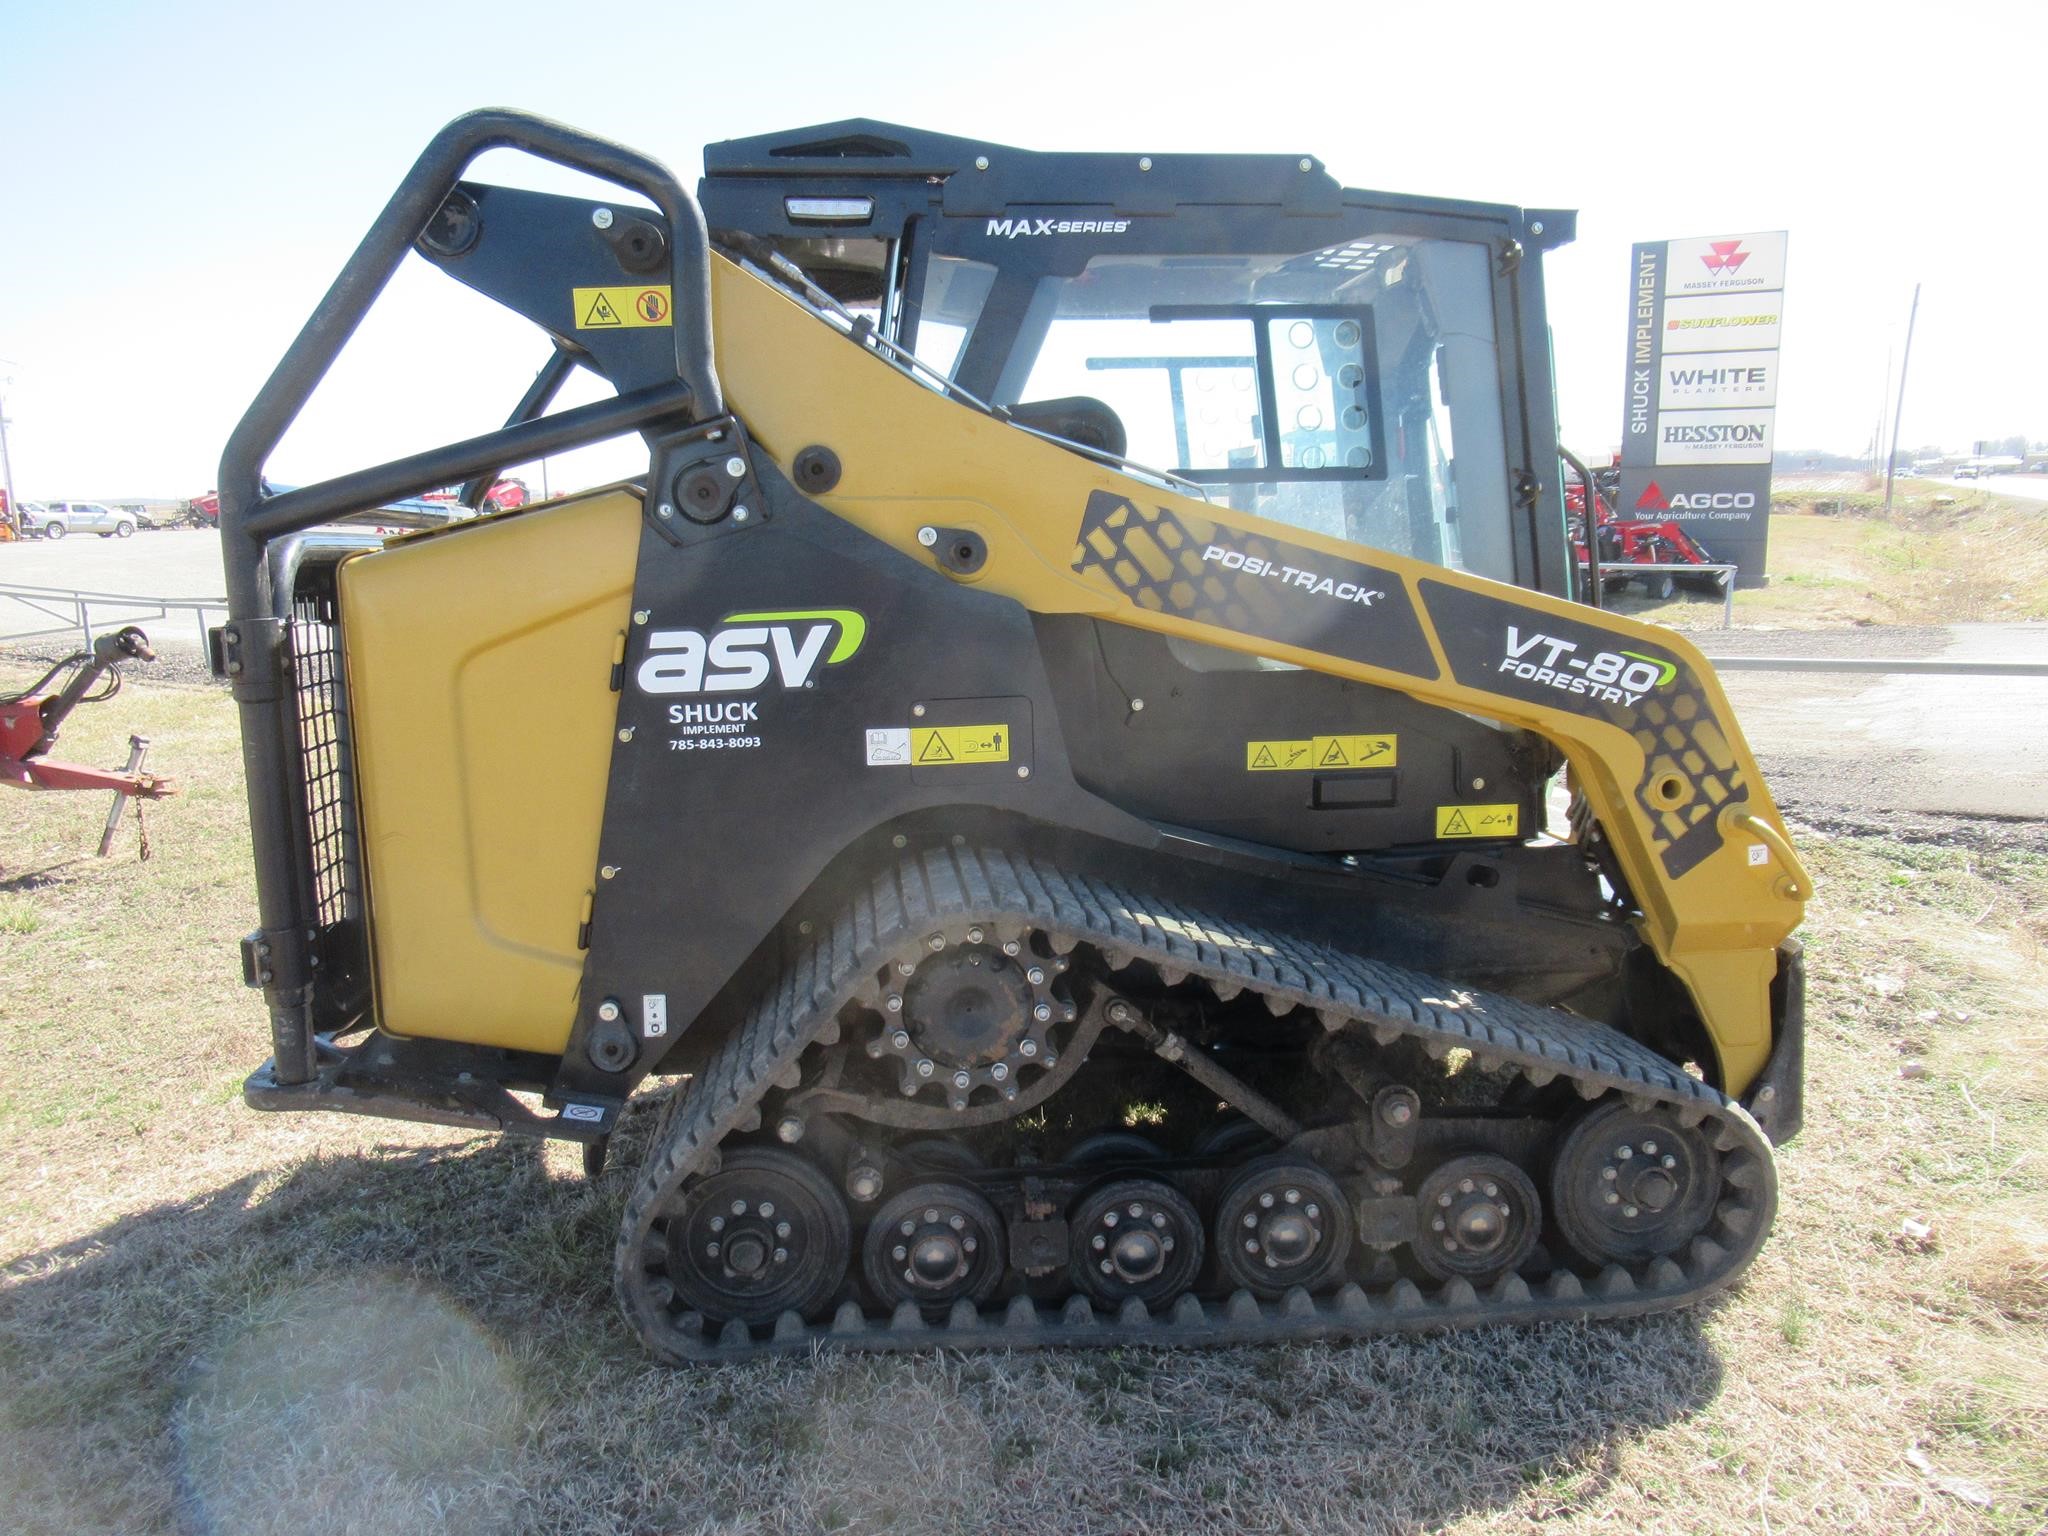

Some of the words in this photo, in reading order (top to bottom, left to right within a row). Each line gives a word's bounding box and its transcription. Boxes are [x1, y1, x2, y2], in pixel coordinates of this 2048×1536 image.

[1683, 280, 1717, 289] MASSEY
[1719, 278, 1765, 287] FERGUSON
[1635, 251, 1657, 364] IMPLEMENT
[1679, 314, 1777, 329] SUNFLOWER
[1669, 367, 1766, 386] WHITE
[1632, 369, 1650, 434] SHUCK
[1664, 424, 1766, 443] HESSTON
[1669, 492, 1755, 509] AGCO
[1634, 512, 1655, 520] Your
[1656, 511, 1706, 521] Agriculture
[1708, 511, 1752, 521] Company
[1506, 625, 1660, 693] VT-80
[1498, 658, 1643, 708] FORESTRY
[669, 702, 759, 724] SHUCK
[683, 723, 746, 735] IMPLEMENT
[669, 737, 761, 750] 785-843-8093
